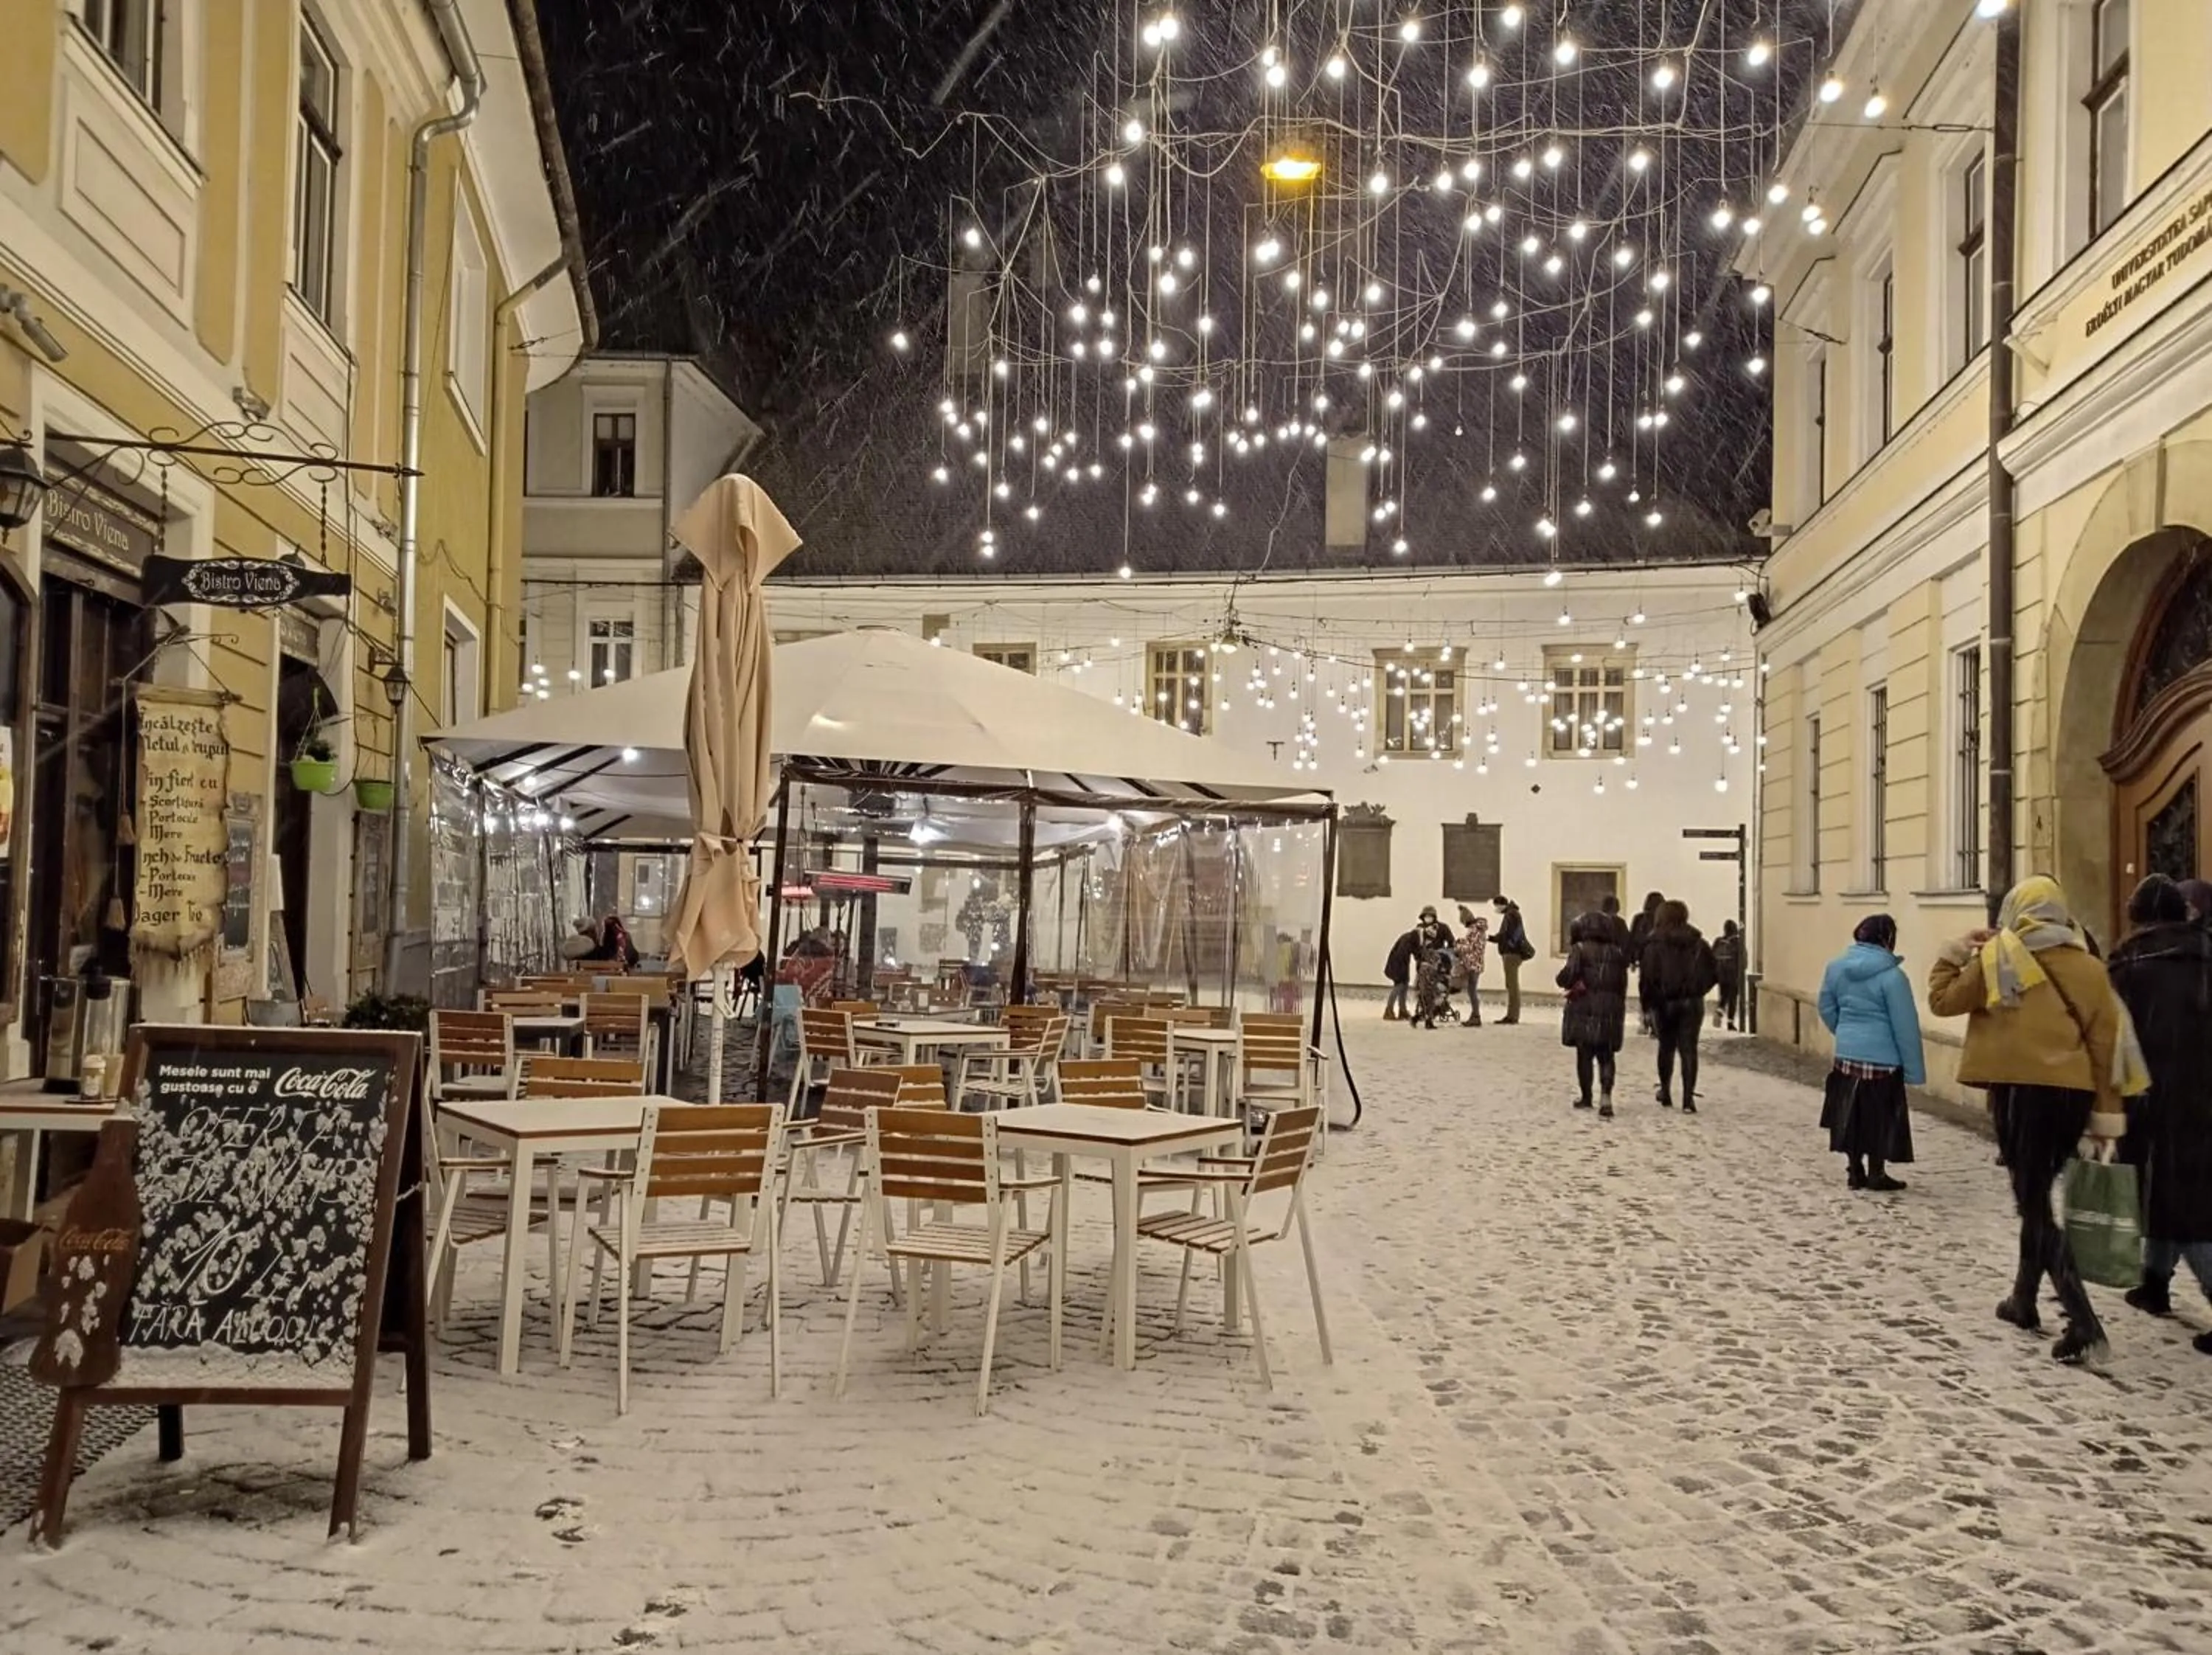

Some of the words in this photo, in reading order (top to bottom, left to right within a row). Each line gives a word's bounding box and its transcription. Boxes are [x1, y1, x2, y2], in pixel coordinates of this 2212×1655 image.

[47, 490, 91, 531] Bistro
[94, 513, 129, 551] Viena
[201, 572, 241, 591] Bistro
[245, 572, 281, 590] Viena
[159, 1065, 208, 1078] Mesele
[212, 1067, 241, 1078] sunt
[244, 1068, 271, 1079] mai
[160, 1081, 224, 1094] gustoase
[227, 1085, 244, 1094] cu
[274, 1067, 377, 1099] Coca-Cola
